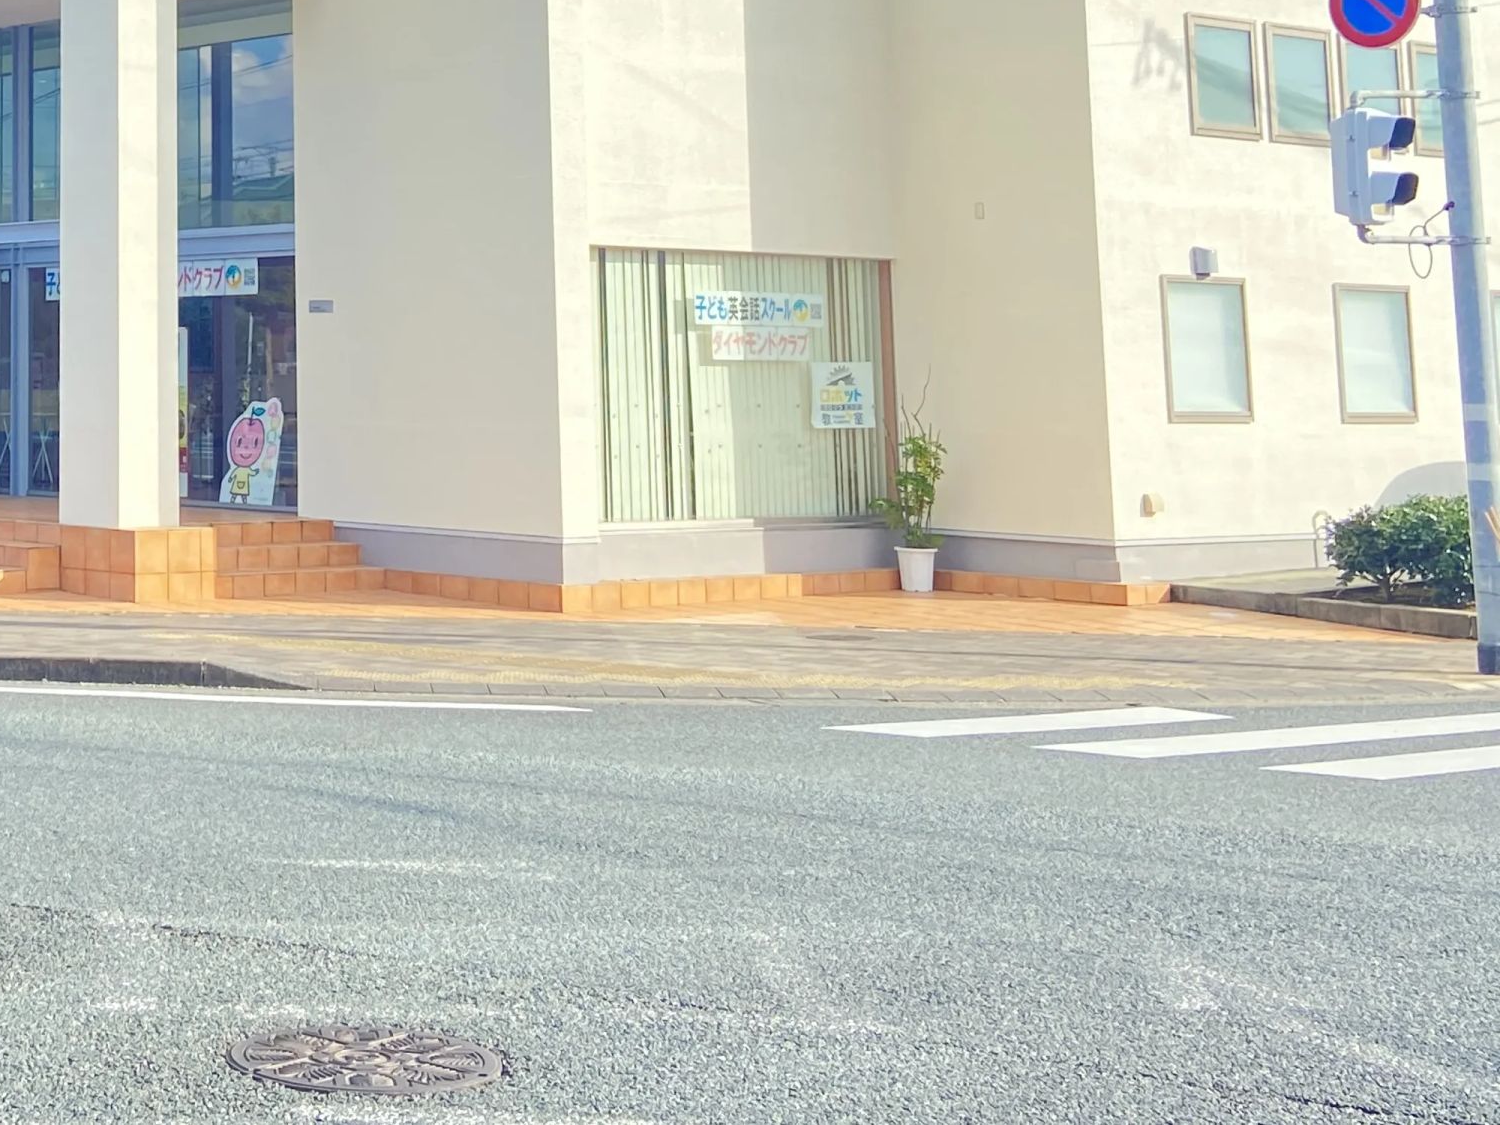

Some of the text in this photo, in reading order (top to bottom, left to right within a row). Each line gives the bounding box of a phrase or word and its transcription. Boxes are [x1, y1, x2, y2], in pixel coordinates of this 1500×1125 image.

[695, 294, 792, 321] 子ども英会話スクール
[712, 331, 809, 357] ダイヤモンドクラブ
[819, 387, 863, 403] ロボット
